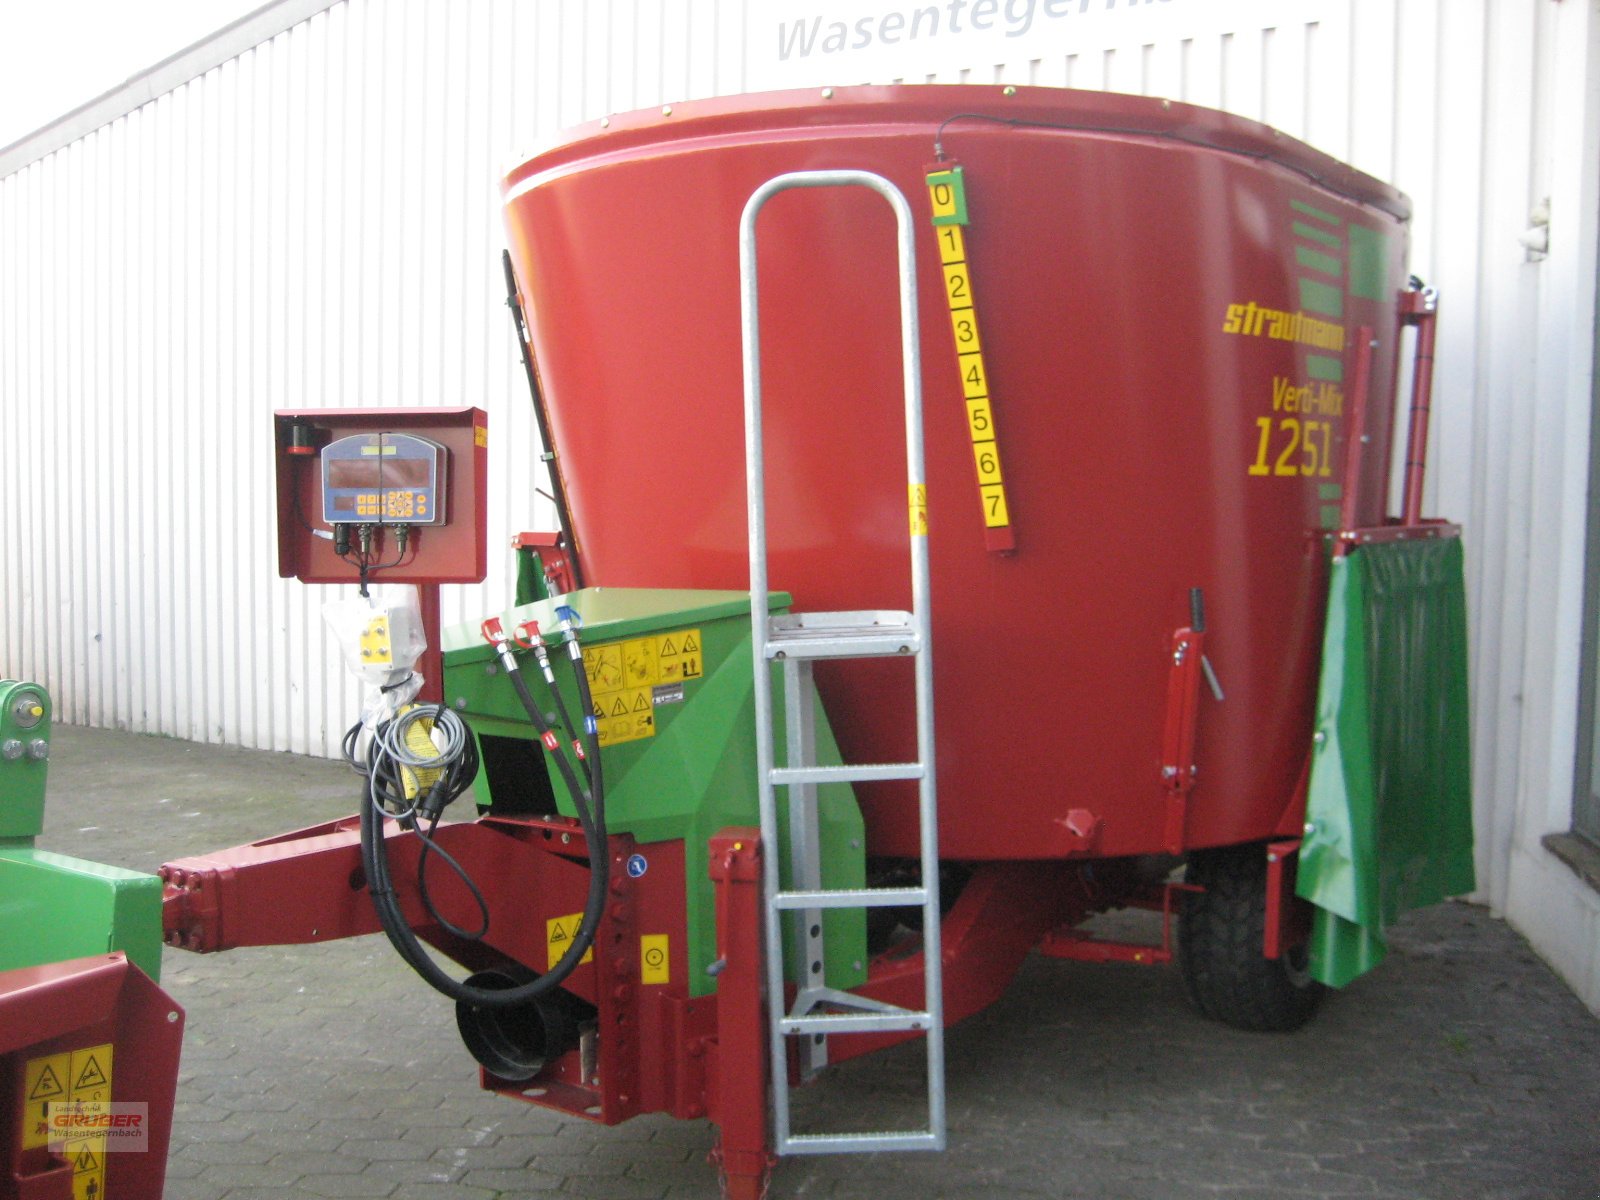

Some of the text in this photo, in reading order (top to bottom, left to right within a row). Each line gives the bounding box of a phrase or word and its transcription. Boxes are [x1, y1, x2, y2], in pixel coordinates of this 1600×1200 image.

[934, 183, 950, 206] 0
[944, 229, 956, 251] 1
[950, 275, 966, 298] 2
[957, 320, 973, 343] 3
[966, 364, 981, 386] 4
[972, 408, 988, 431] 5
[1248, 416, 1332, 477] 1251
[980, 452, 996, 474] 6
[986, 495, 1001, 517] 7
